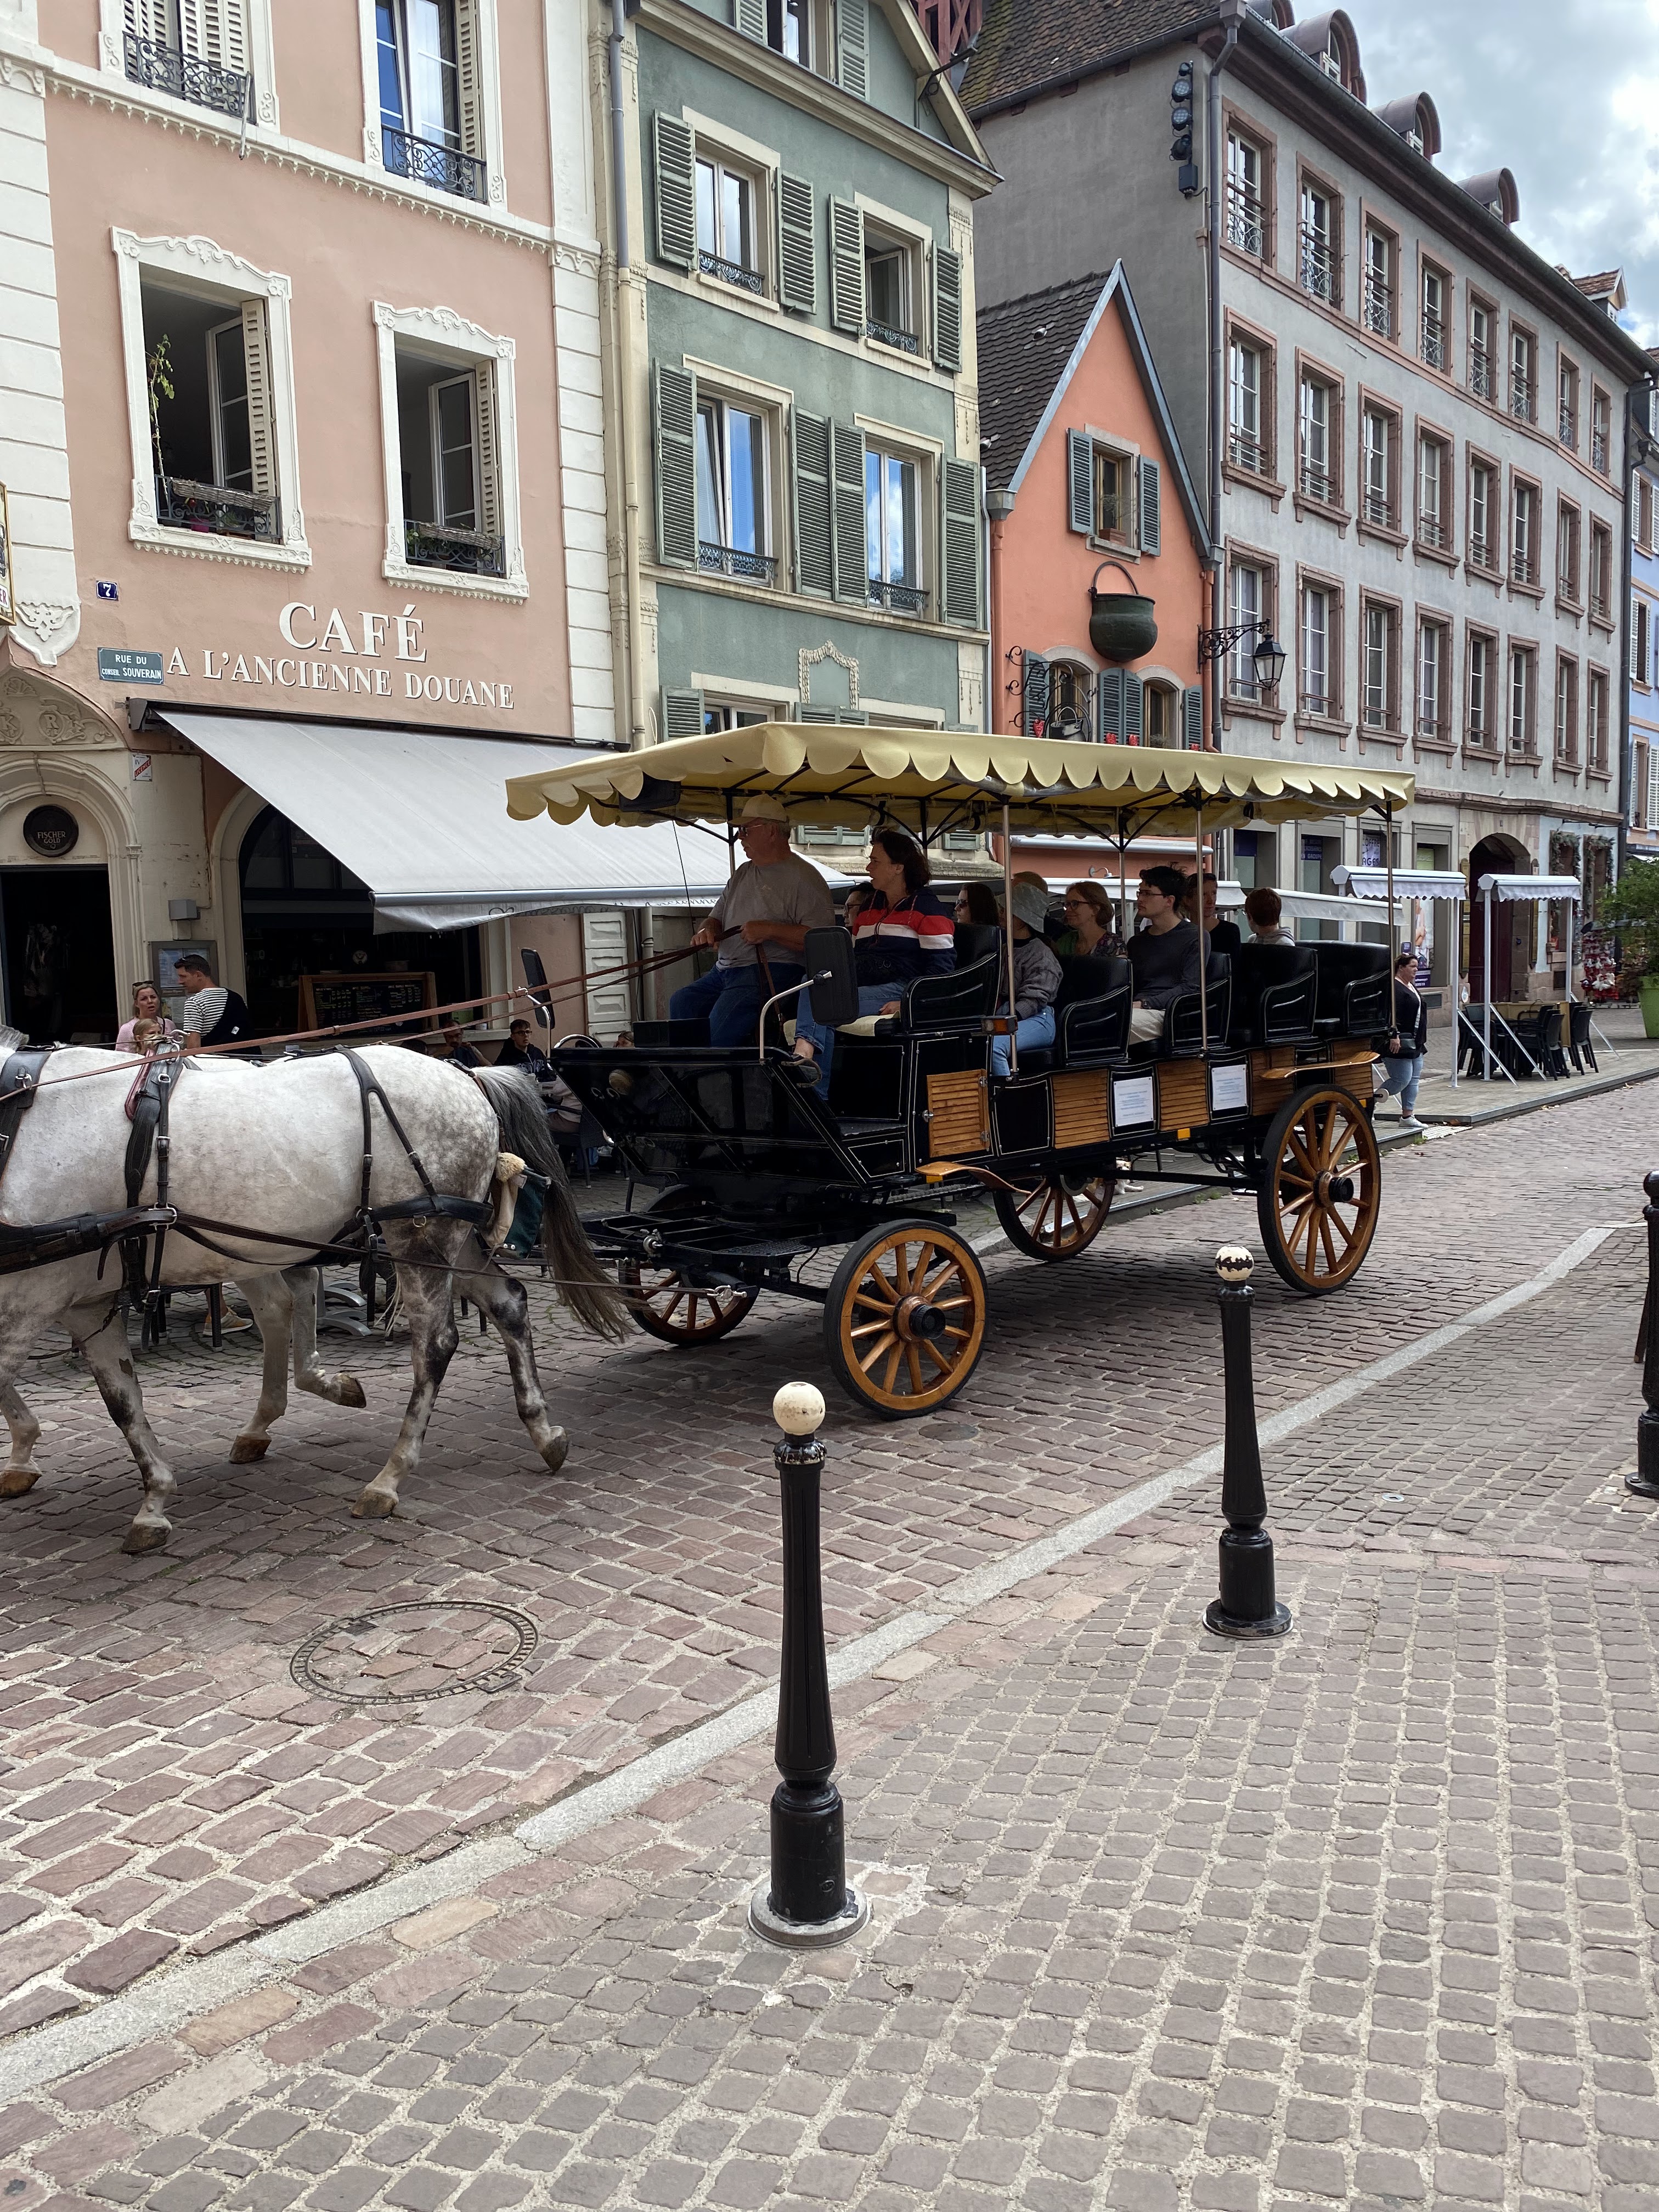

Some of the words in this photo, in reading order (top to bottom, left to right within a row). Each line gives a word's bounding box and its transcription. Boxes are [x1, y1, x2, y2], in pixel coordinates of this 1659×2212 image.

[103, 583, 111, 597] 7
[279, 601, 427, 662] CAFÉ
[115, 654, 132, 664] RUE
[136, 656, 147, 665] DU
[101, 668, 120, 676] CONSEIL
[122, 667, 162, 679] SOUVERAIN
[167, 647, 190, 676] A
[201, 649, 392, 696] L'ANCIENNE
[404, 672, 515, 709] DOUANE
[44, 714, 60, 729] R
[37, 831, 66, 839] FISCHER
